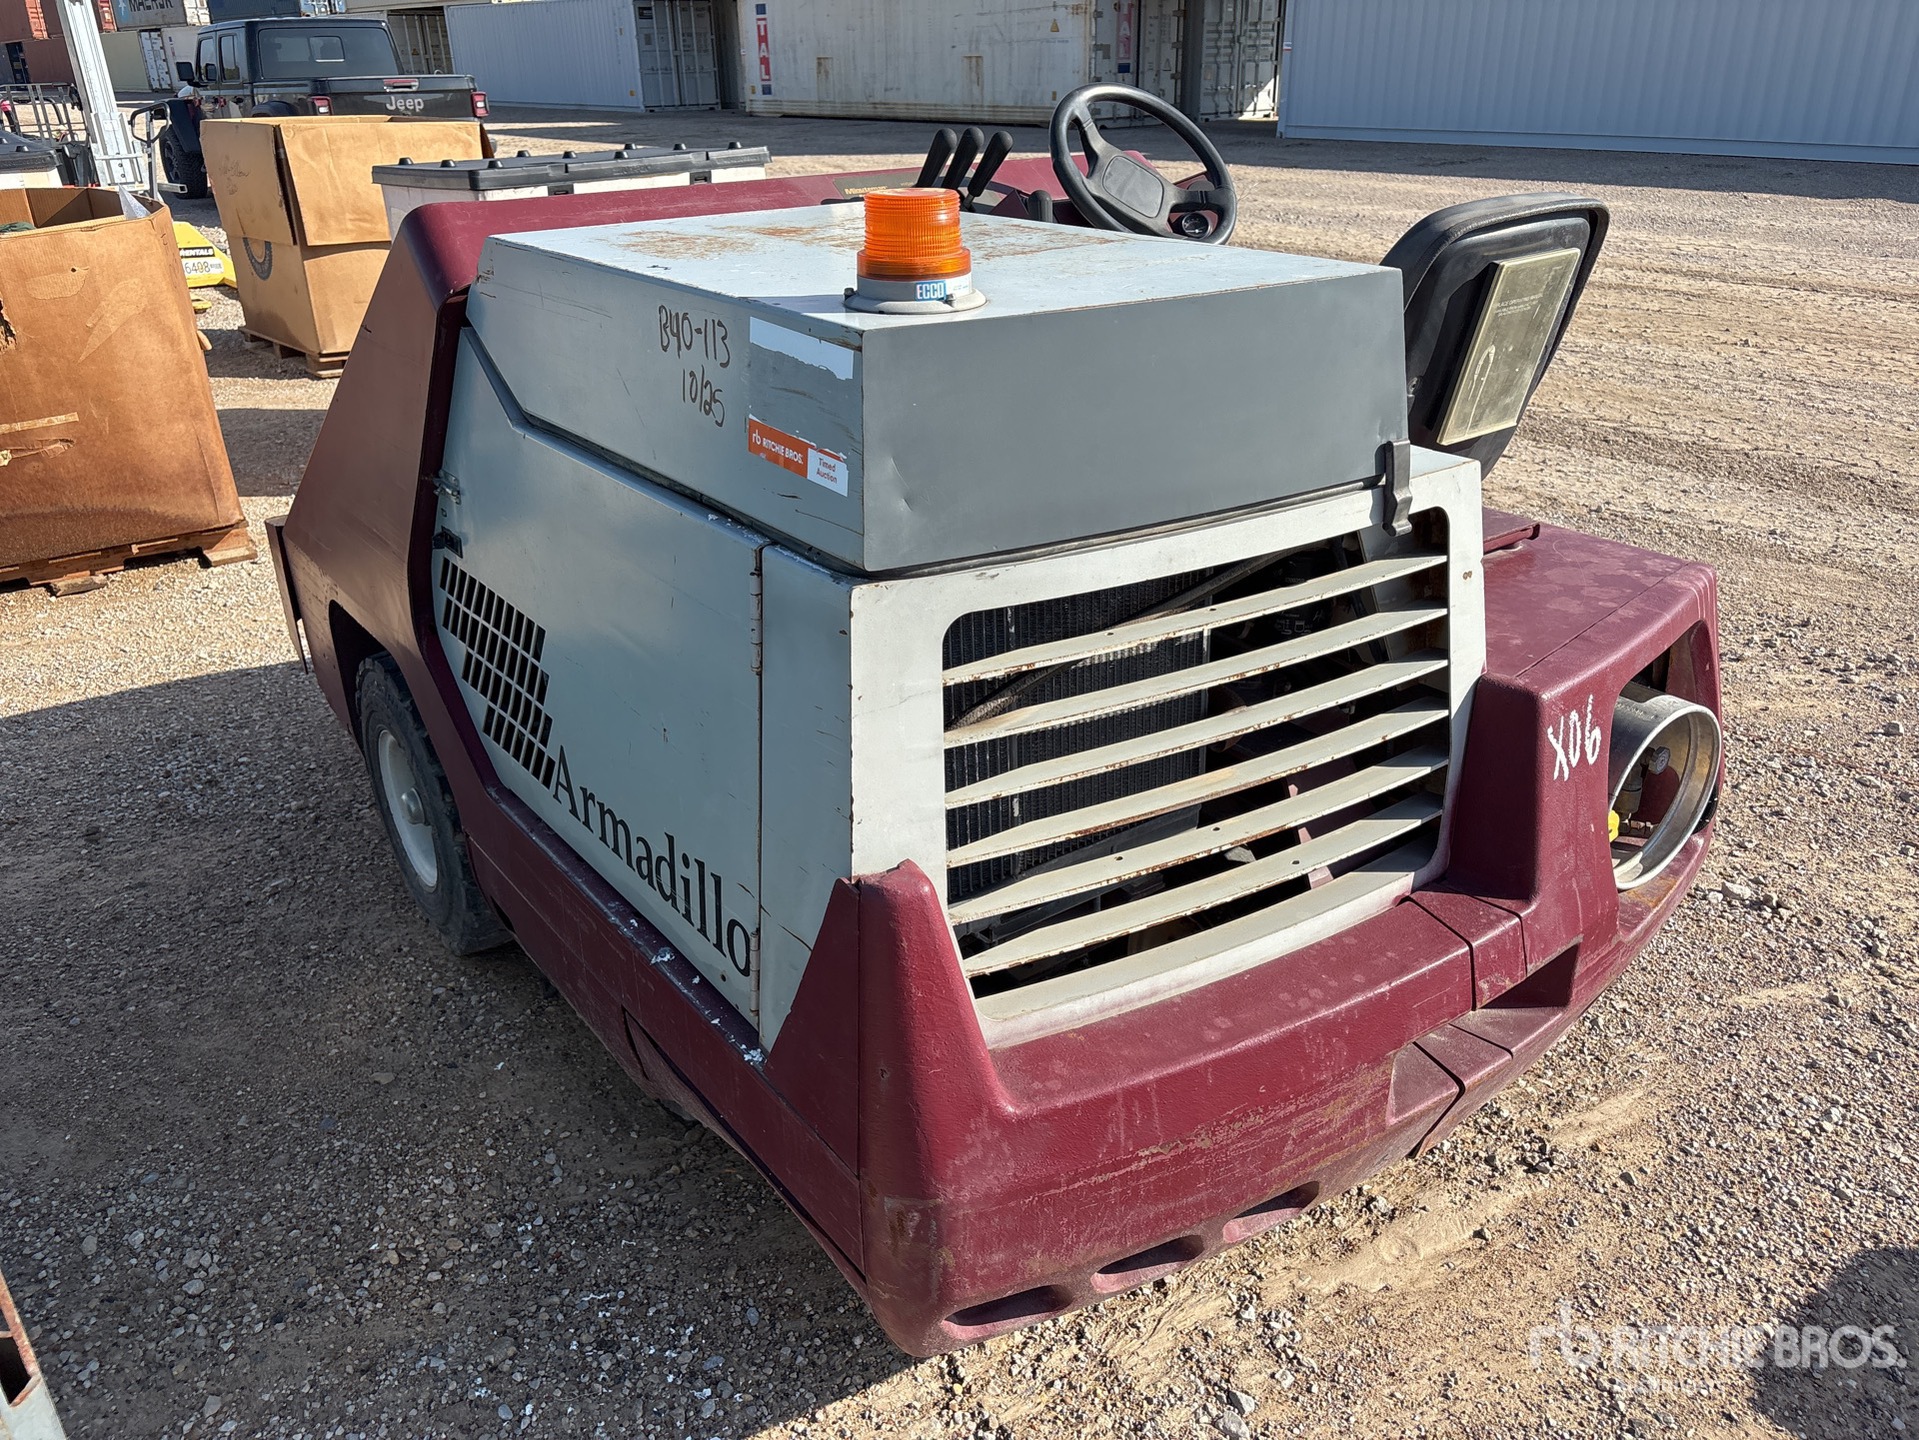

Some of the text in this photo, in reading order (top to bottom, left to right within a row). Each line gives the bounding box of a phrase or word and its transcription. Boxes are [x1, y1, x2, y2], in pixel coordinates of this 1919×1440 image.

[757, 20, 770, 80] TAL
[385, 95, 425, 113] Jeep
[916, 282, 944, 299] ECCO
[659, 304, 731, 369] B40-113
[683, 364, 726, 428] 10/25
[763, 438, 784, 456] RITCHIE
[819, 457, 836, 472] Timed
[816, 468, 837, 484] Auction
[552, 744, 751, 978] Armadillo
